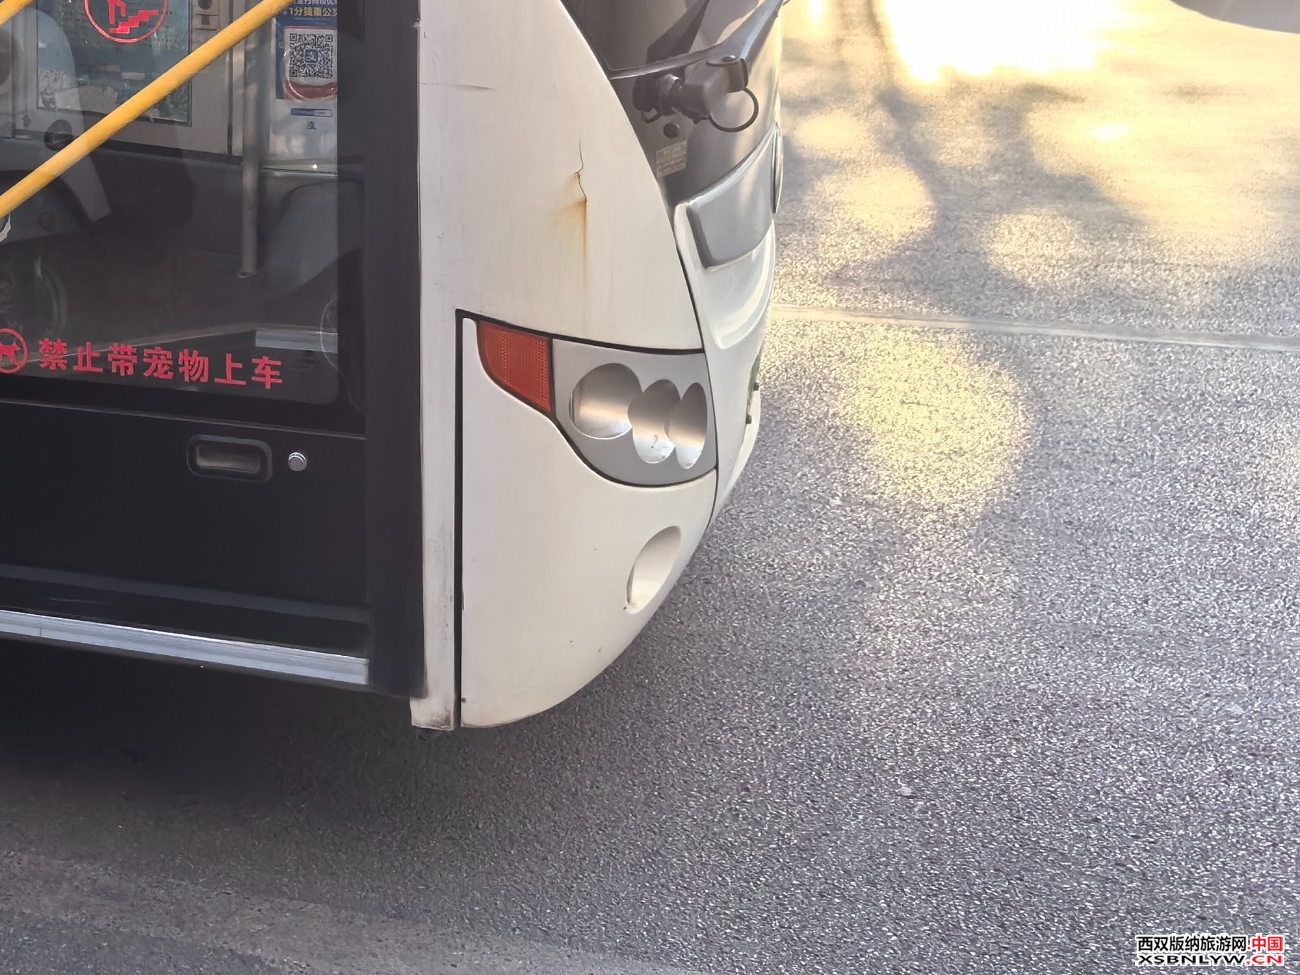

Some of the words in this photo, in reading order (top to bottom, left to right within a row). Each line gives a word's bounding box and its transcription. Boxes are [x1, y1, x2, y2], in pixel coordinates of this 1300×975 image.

[38, 337, 284, 390] 禁止带宠物上车
